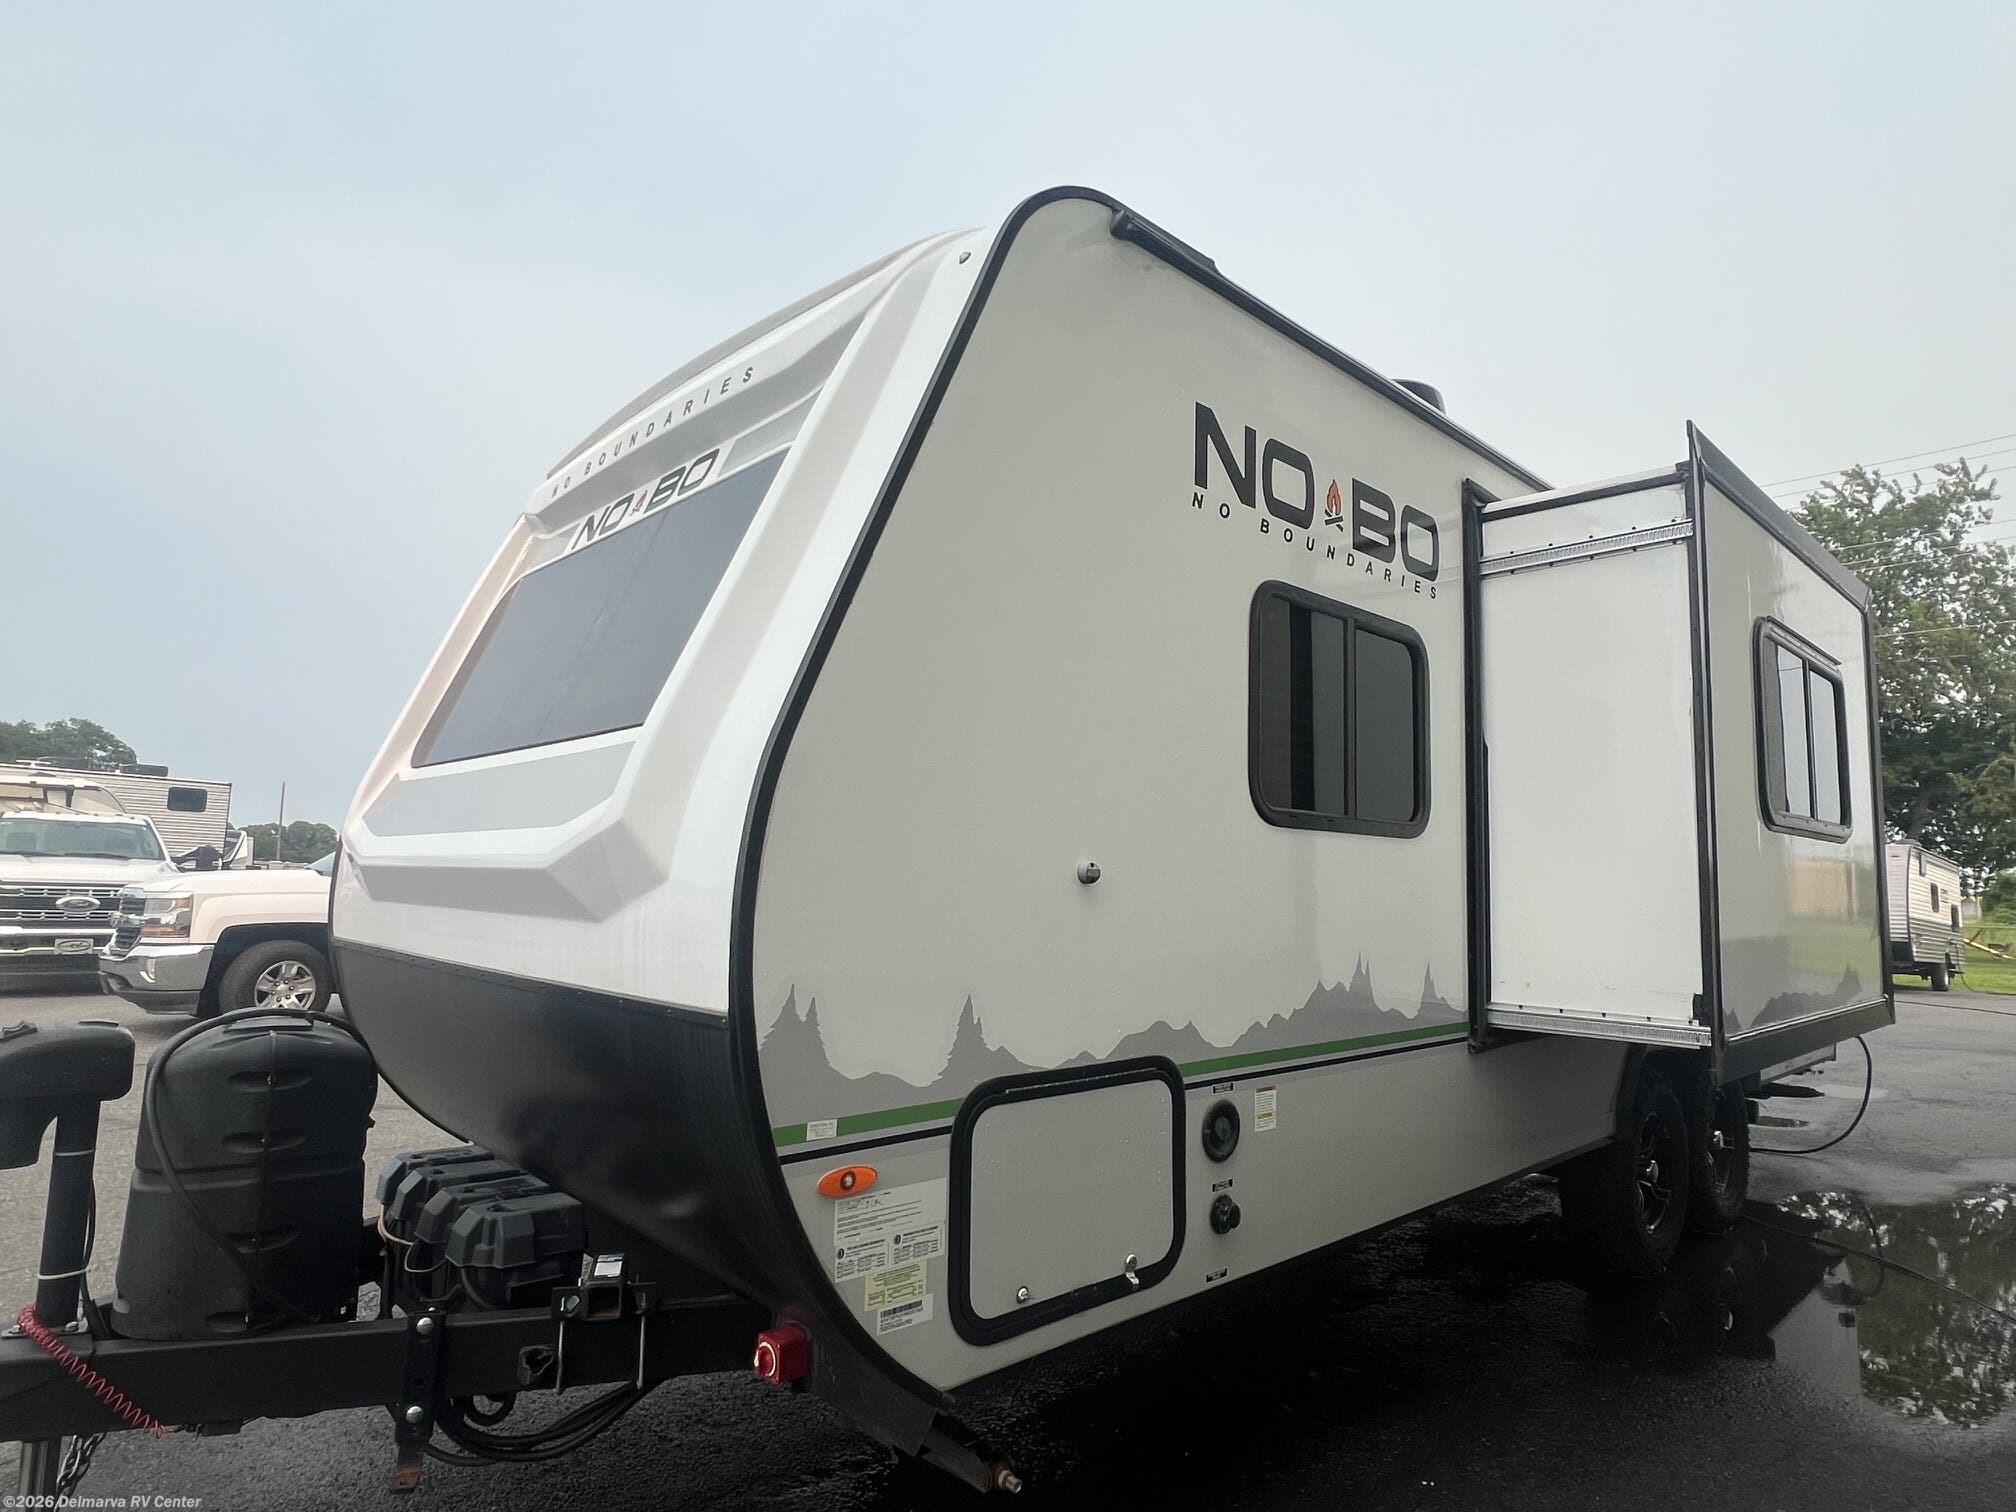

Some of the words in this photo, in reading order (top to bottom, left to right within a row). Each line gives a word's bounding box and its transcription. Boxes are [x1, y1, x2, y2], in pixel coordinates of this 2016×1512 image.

[552, 476, 571, 498] NO
[584, 367, 754, 476] BOUNDARIES
[1194, 401, 1316, 530] NO
[1351, 477, 1439, 582] BO
[571, 493, 635, 550] NO
[643, 448, 721, 514] BO
[1191, 491, 1231, 519] NO
[1259, 517, 1438, 600] BOUNDARIES
